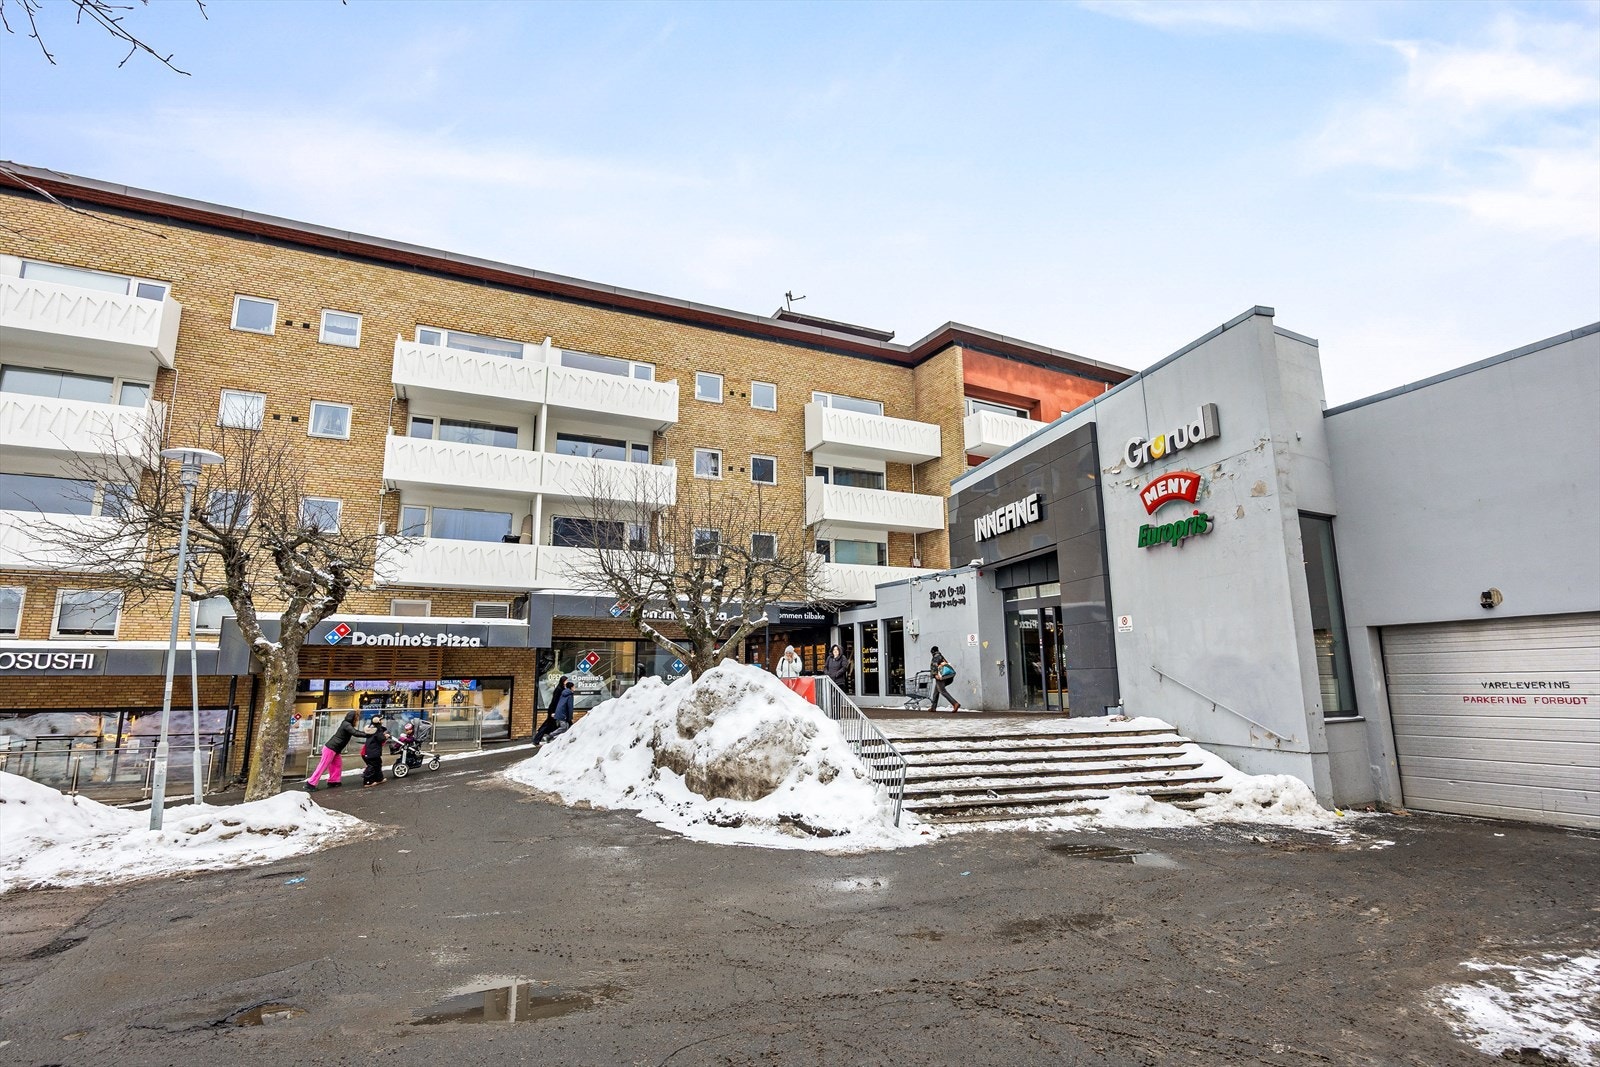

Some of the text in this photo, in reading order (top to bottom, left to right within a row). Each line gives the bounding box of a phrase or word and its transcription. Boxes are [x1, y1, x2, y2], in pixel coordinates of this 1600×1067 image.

[1143, 478, 1191, 506] MENY
[974, 493, 1039, 543] INNGANG
[1138, 510, 1208, 548] Europris
[803, 611, 826, 620] tilbake
[352, 631, 480, 647] Domino's Pizza
[0, 652, 94, 670] OSUSHI
[1481, 681, 1571, 689] VARELEVERING
[1463, 696, 1588, 705] PARKERING FORBUDT
